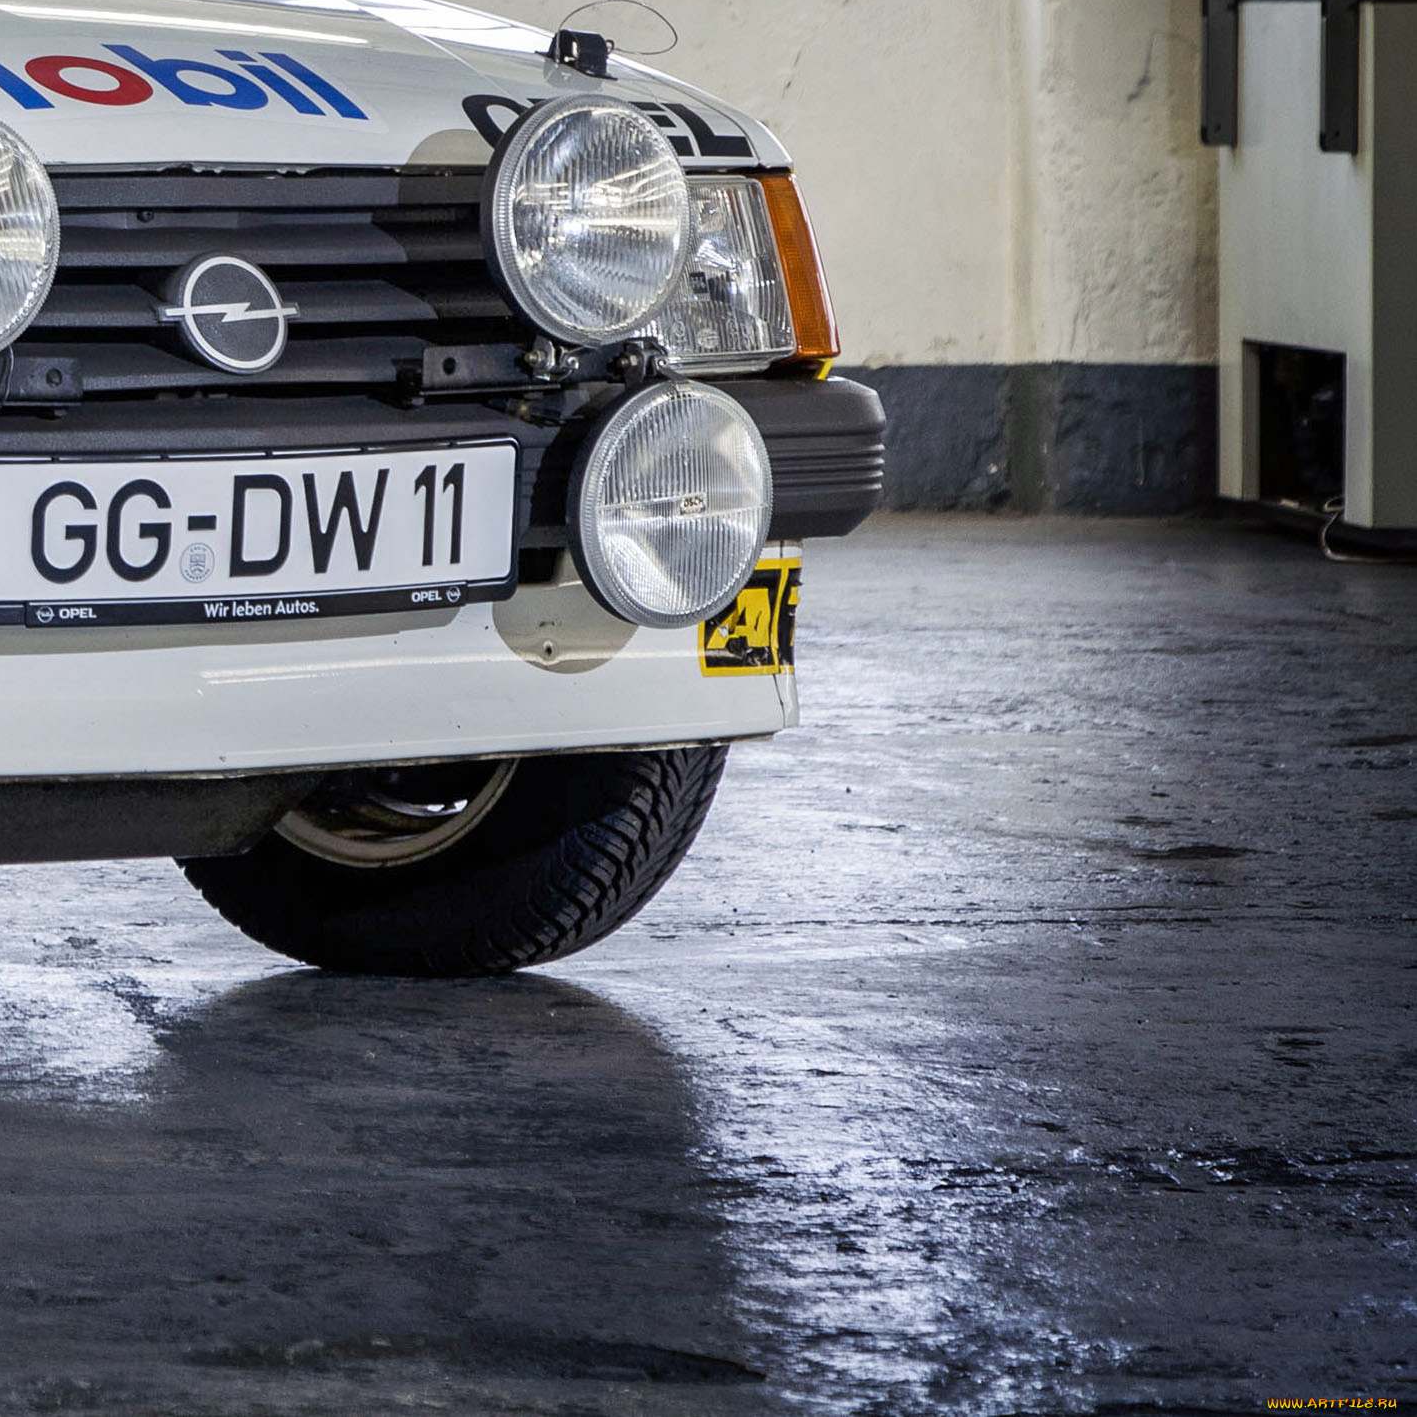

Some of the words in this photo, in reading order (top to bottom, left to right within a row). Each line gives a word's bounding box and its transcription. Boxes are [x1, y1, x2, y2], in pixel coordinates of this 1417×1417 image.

[461, 92, 754, 158] OEL
[413, 462, 466, 567] 11
[411, 590, 443, 603] OPEL
[58, 607, 97, 619] OPEL
[204, 602, 230, 618] Wir
[231, 601, 272, 617] leben
[274, 600, 320, 616] Autos.
